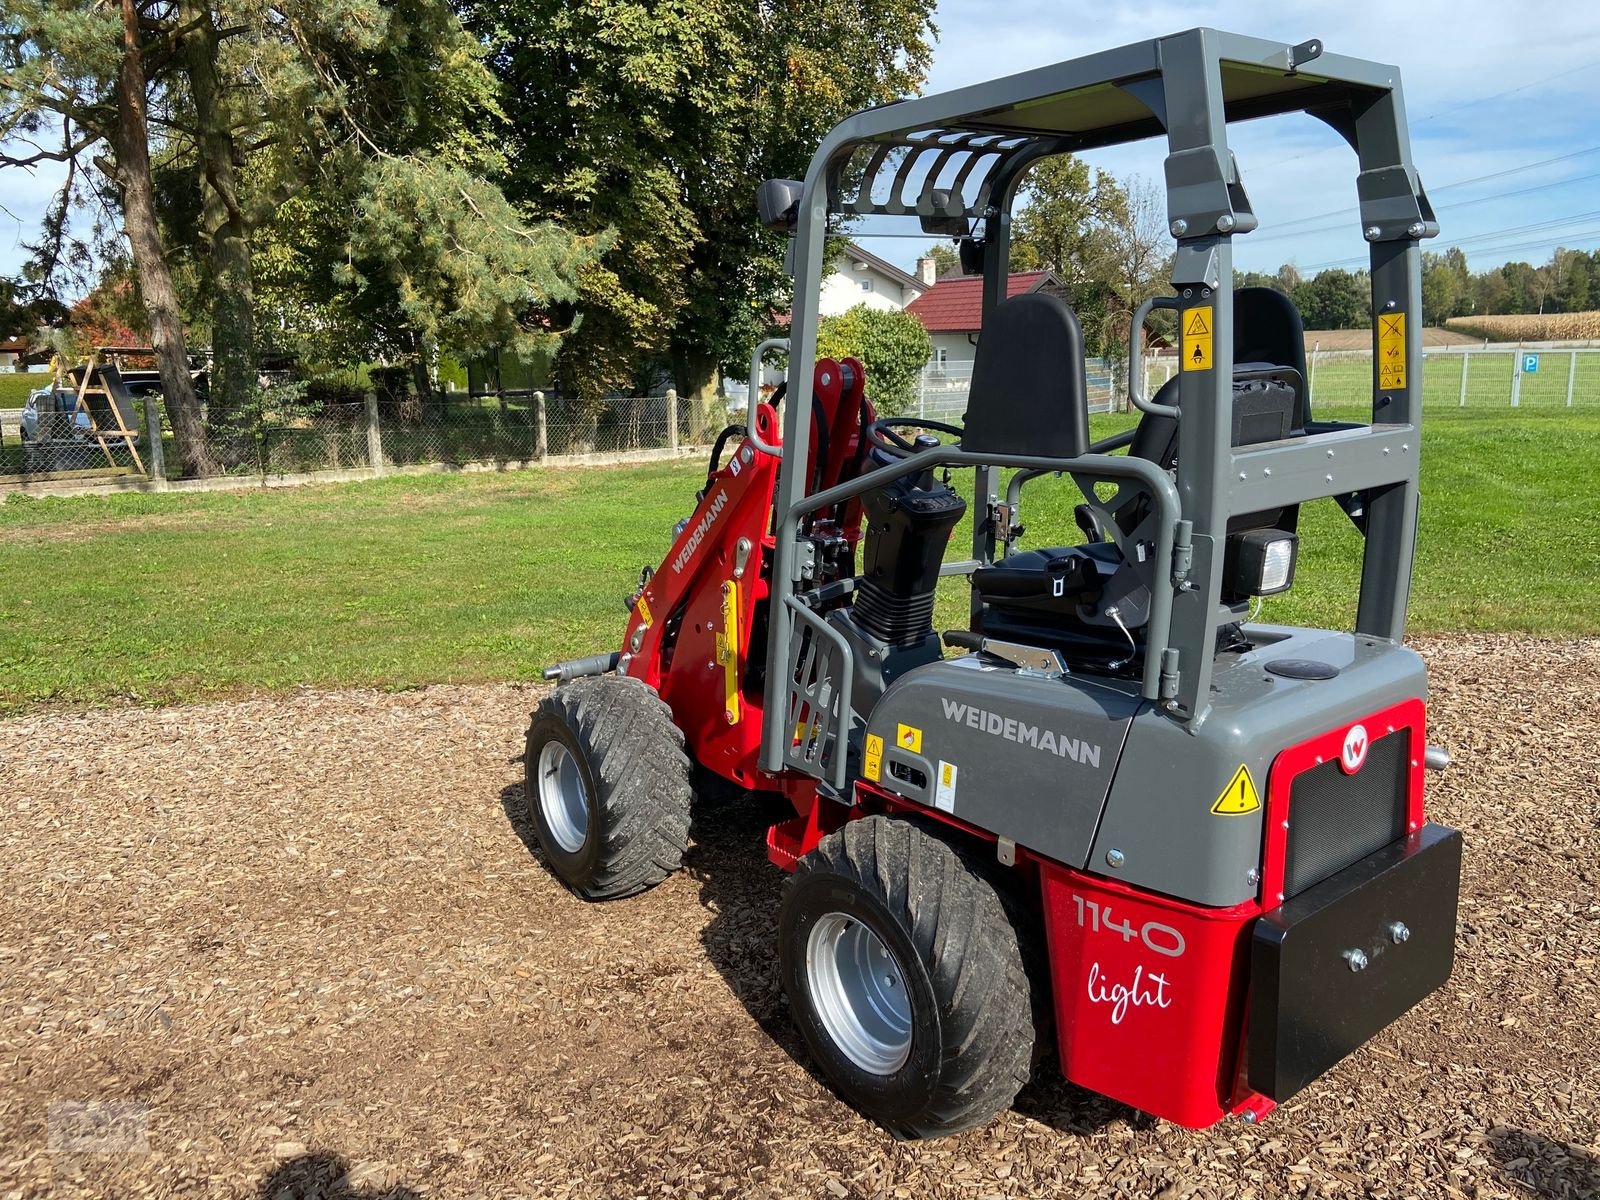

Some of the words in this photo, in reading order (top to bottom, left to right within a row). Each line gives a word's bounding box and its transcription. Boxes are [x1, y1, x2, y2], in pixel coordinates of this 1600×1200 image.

[1526, 357, 1536, 371] P
[672, 488, 728, 574] WEIDEMANN
[941, 697, 1101, 768] WEIDEMANN
[1072, 894, 1186, 957] 1140
[1088, 962, 1172, 1024] light
